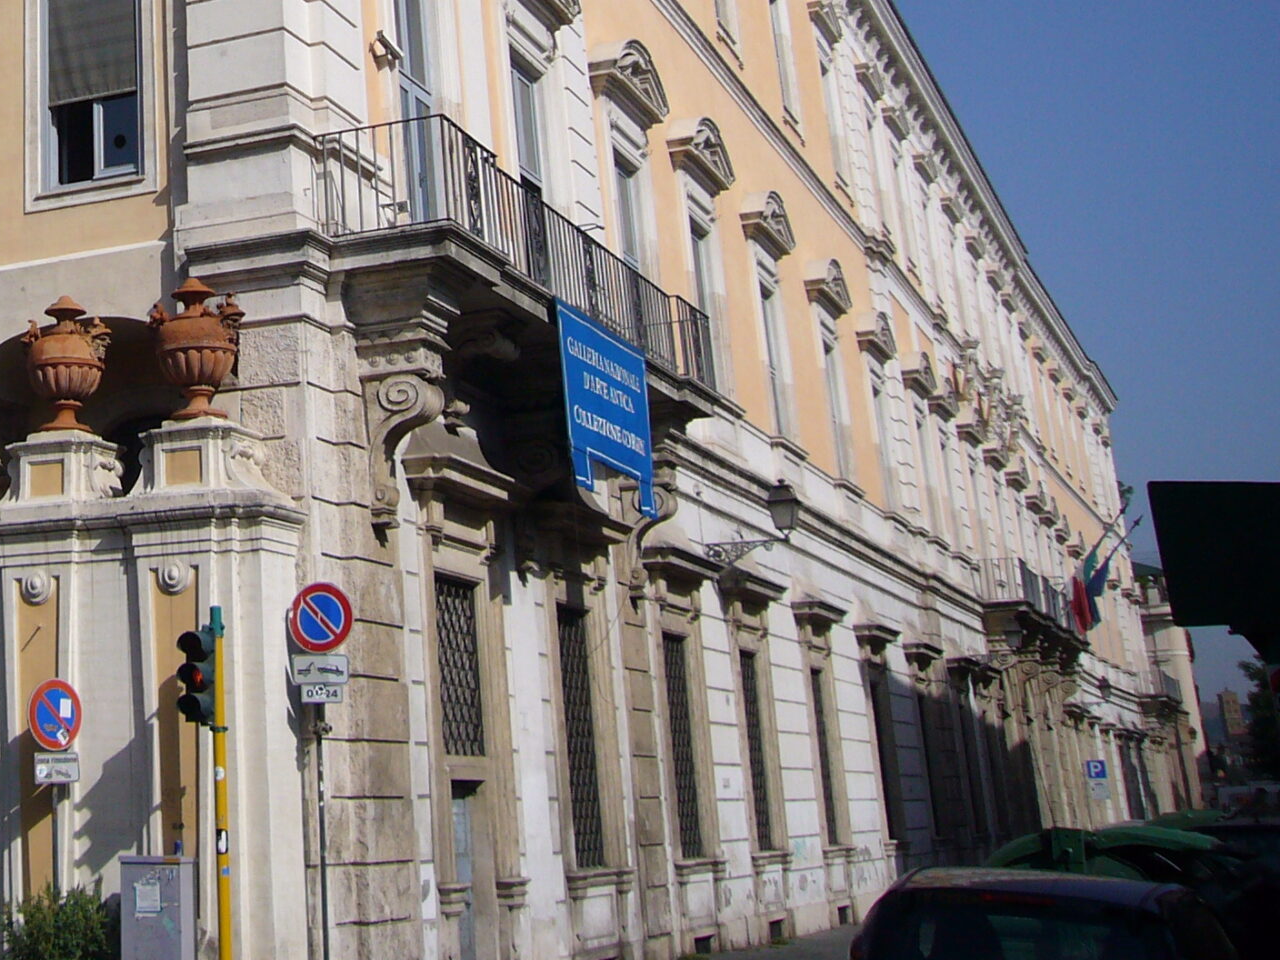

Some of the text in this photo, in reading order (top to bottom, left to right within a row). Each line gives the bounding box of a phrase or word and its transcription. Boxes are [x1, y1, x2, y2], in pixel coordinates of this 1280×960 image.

[567, 336, 640, 393] GALLERIA NAZIONALE
[583, 371, 635, 414] D'ARTE ANTICA
[574, 404, 621, 443] COLLEZIONE
[1090, 761, 1102, 778] P
